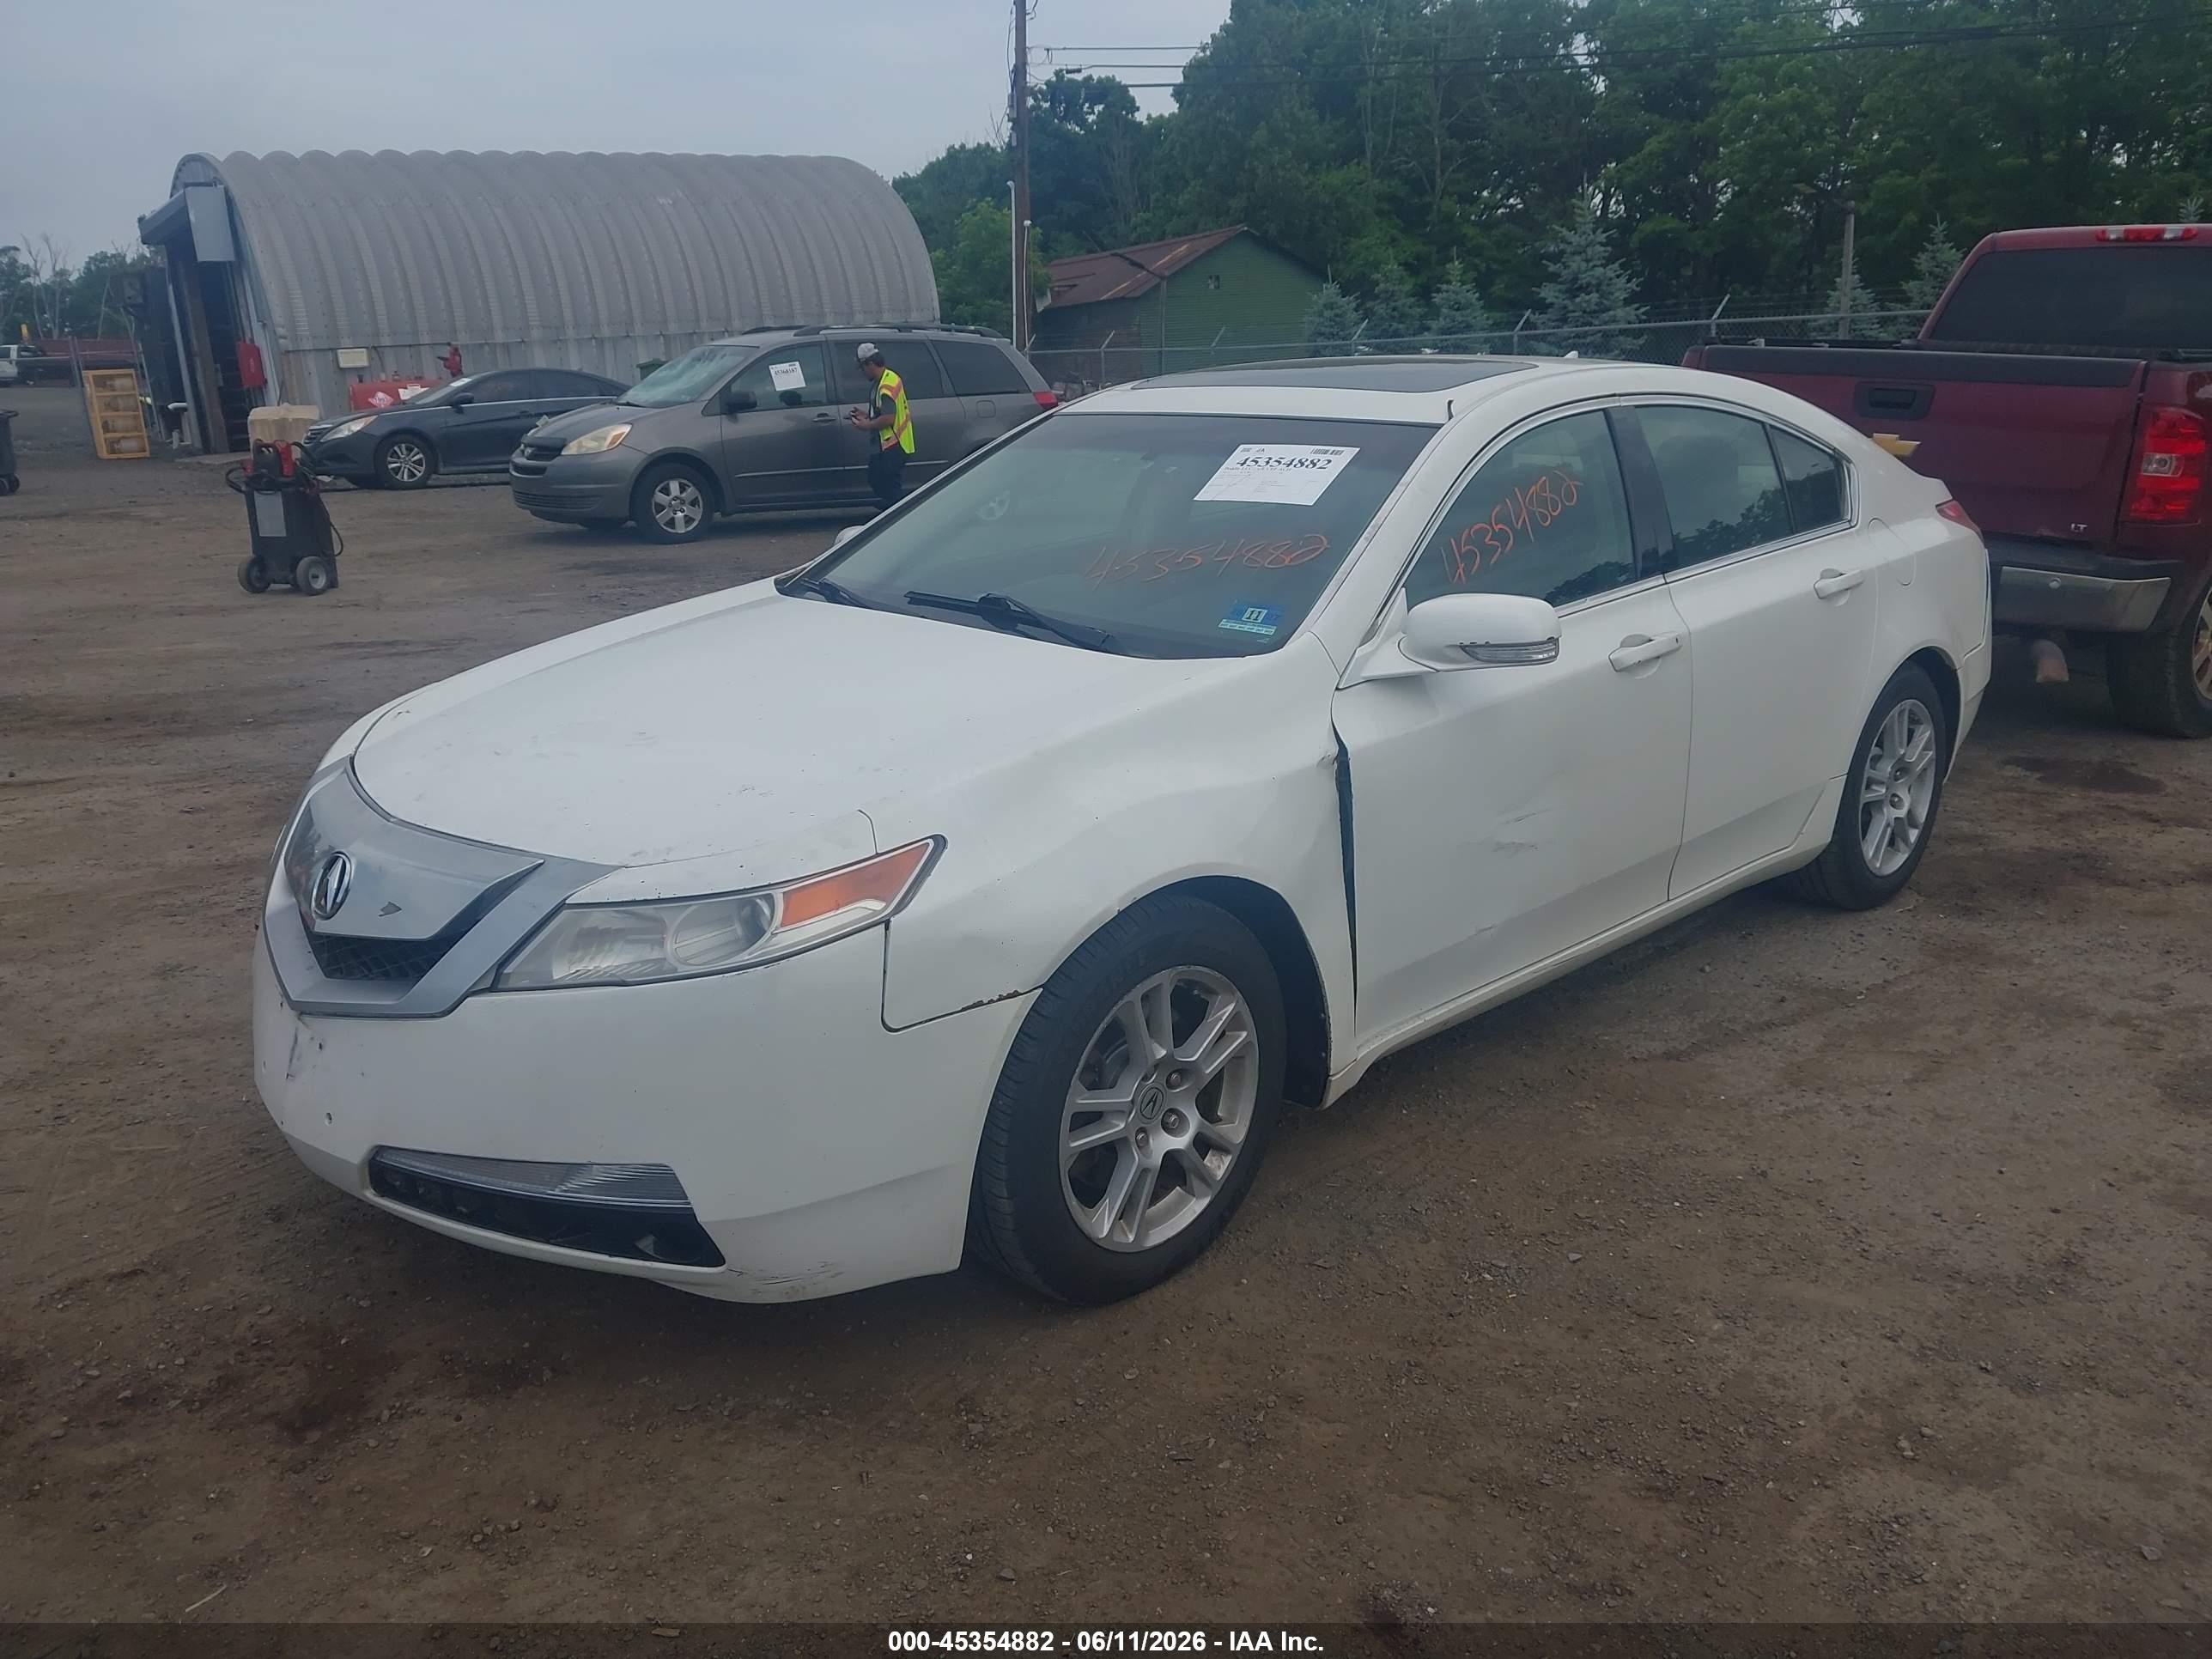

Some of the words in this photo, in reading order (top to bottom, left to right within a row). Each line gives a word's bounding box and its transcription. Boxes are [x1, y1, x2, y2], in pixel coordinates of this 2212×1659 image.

[1236, 456, 1333, 470] 45354882
[1441, 470, 1584, 585] 45354882
[2070, 522, 2087, 532] LT
[1085, 534, 1330, 591] 45354882
[1245, 610, 1263, 622] 11
